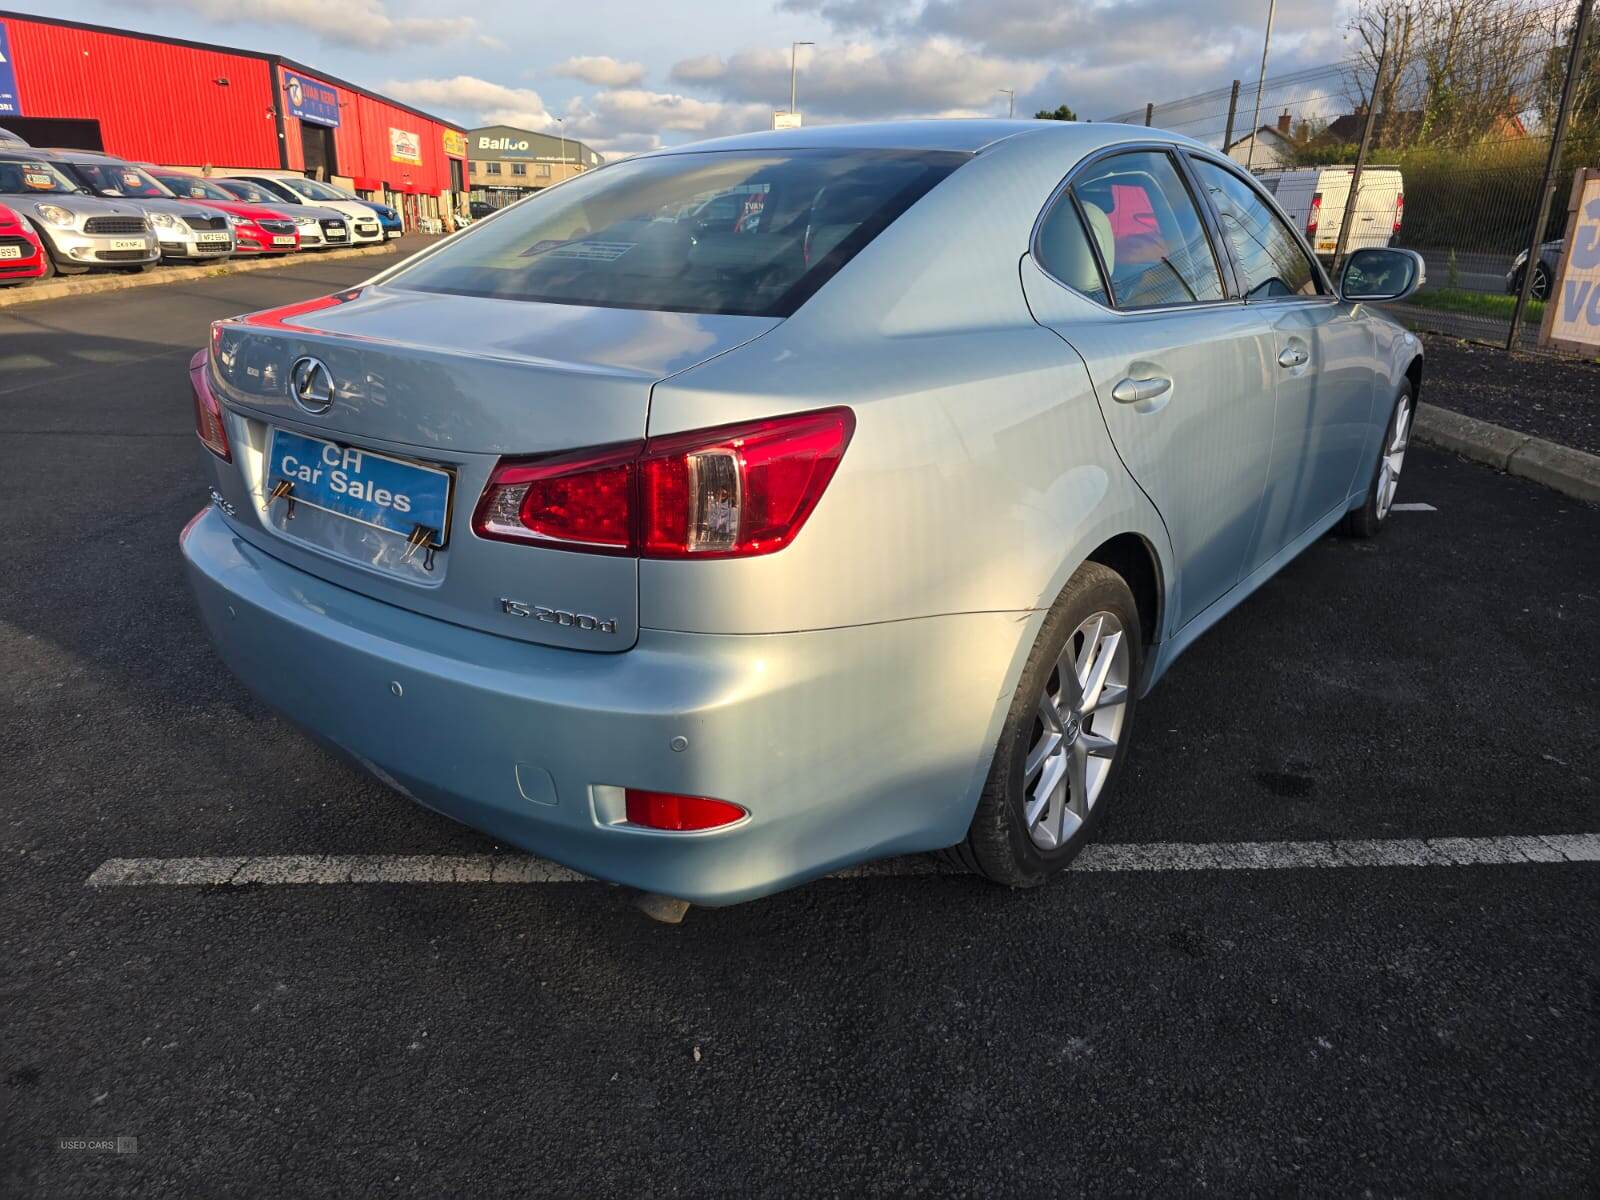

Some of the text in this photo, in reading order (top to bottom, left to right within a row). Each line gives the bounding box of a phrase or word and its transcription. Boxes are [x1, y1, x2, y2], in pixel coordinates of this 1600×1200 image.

[321, 444, 362, 473] CH
[280, 455, 412, 513] Car Sales
[534, 605, 617, 633] 200d
